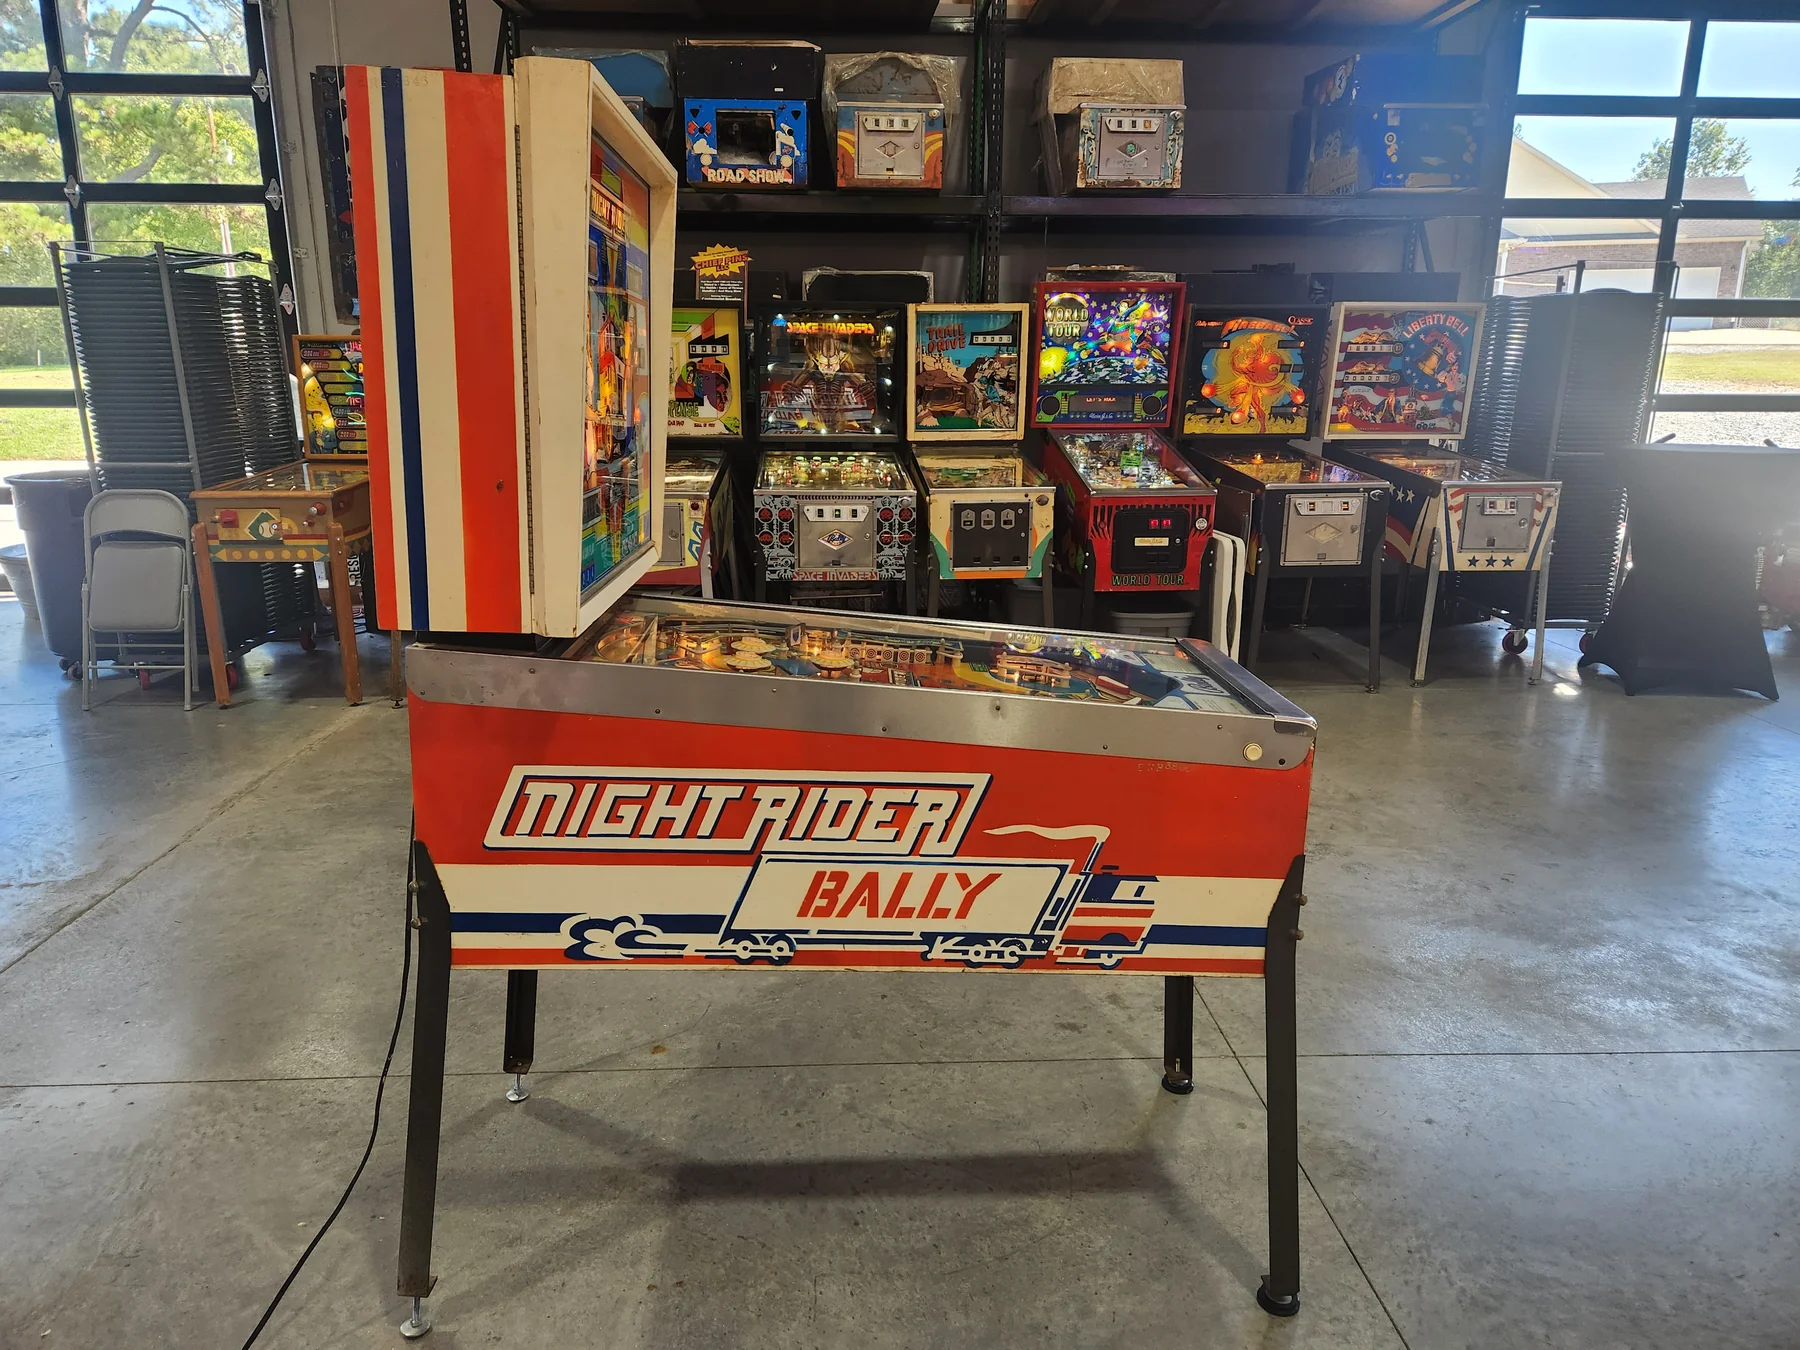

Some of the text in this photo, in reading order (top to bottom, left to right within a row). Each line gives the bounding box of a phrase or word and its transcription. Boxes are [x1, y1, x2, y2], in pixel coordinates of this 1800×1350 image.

[707, 168, 785, 184] ROAD SHOW
[695, 256, 724, 270] CHIEF
[724, 253, 749, 266] PINS
[716, 264, 730, 272] LLC
[1043, 307, 1089, 322] WORLD
[786, 321, 875, 335] SPACE INVADERS
[926, 323, 966, 340] TRAIL
[1047, 322, 1082, 338] TOUR
[1402, 313, 1470, 338] LIBERTY BELL
[927, 336, 966, 354] DRIVE
[792, 571, 878, 581] SPACE INVADERS
[1112, 574, 1184, 586] WORLD TOUR
[514, 780, 962, 850] NIGHT RIDER
[796, 870, 1003, 919] BALLY
